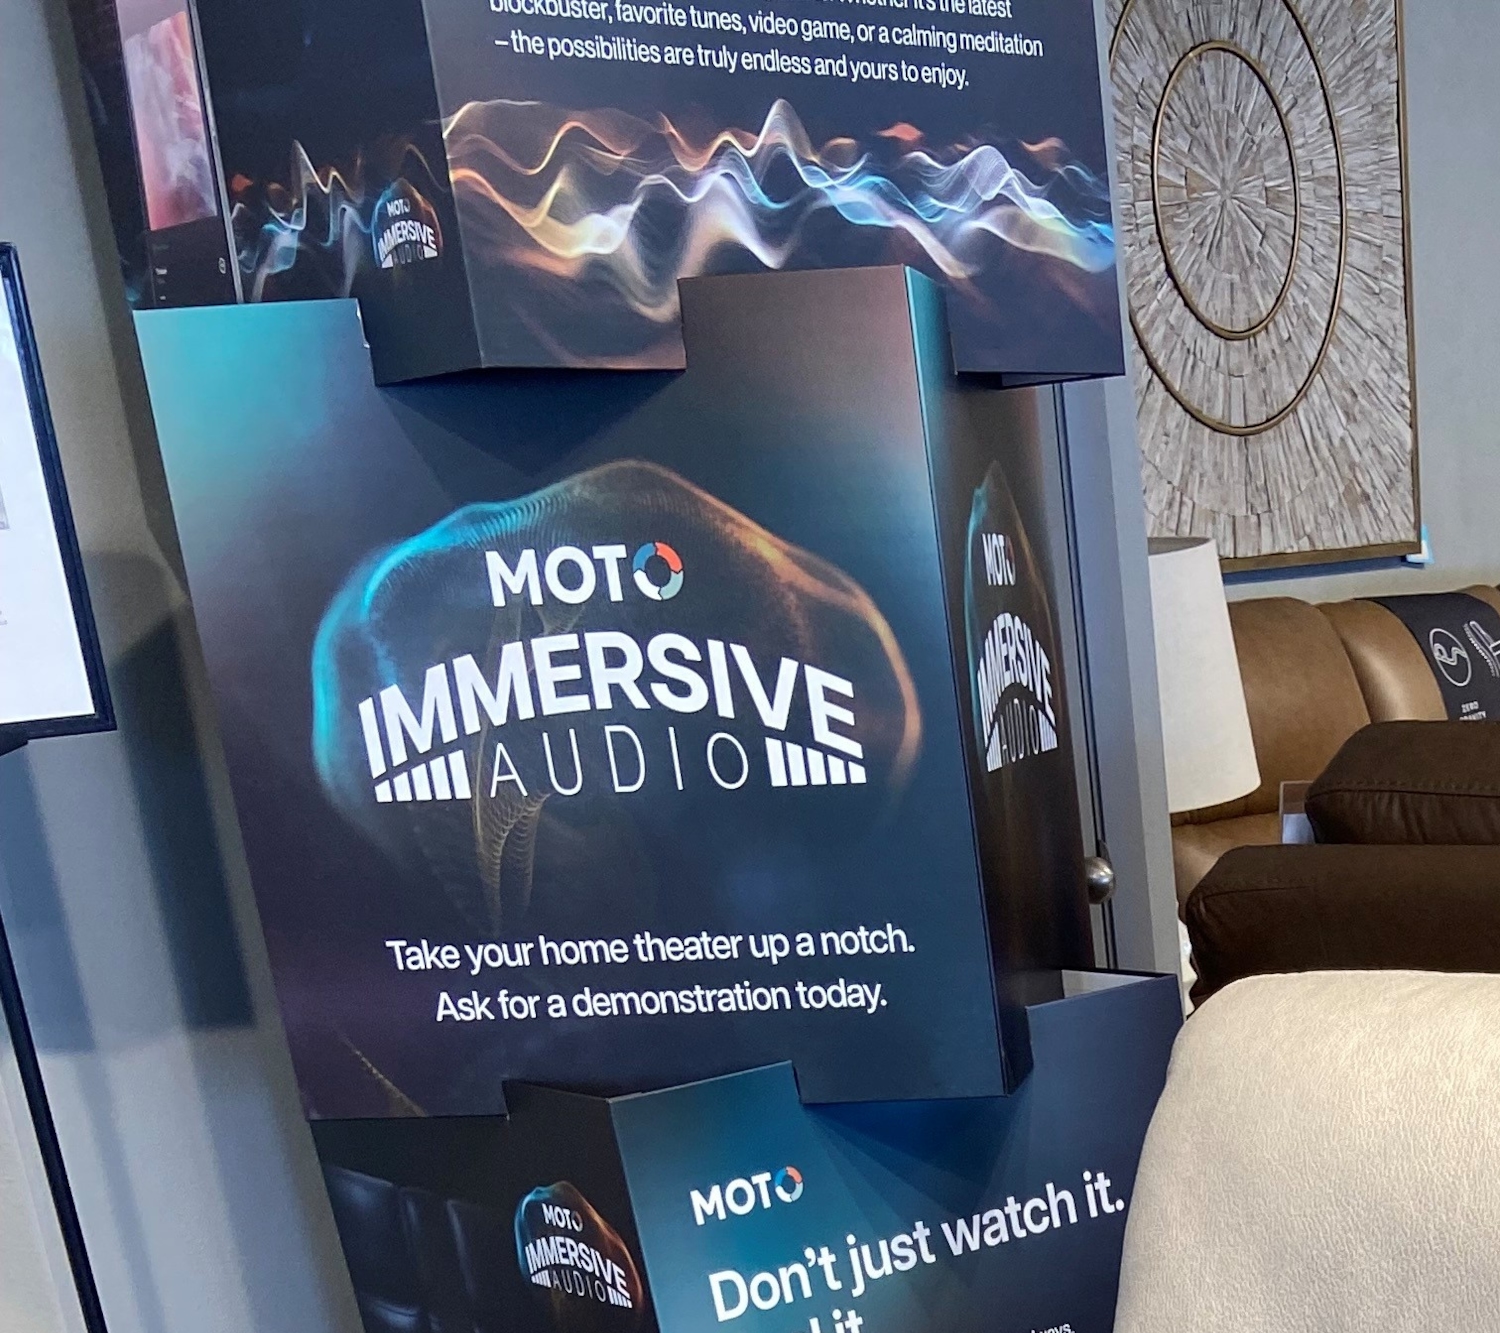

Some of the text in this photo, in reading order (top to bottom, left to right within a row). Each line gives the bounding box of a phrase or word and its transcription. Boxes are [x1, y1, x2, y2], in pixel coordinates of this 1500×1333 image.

[490, 0, 1044, 57] blockbuster, favorite tunes, video game, or a calming meditation
[968, 0, 1013, 18] latest
[511, 29, 545, 55] the
[548, 36, 662, 63] possibilities
[664, 47, 695, 67] are
[697, 44, 740, 73] truly
[741, 49, 812, 75] endless
[814, 54, 847, 78] and
[850, 61, 898, 82] yours
[901, 60, 920, 83] to
[921, 62, 970, 90] enjoy.
[386, 198, 411, 217] MOTO
[377, 220, 437, 262] IMMERSIVE
[392, 244, 424, 265] AUDIO
[485, 541, 684, 607] MOTO
[982, 533, 1016, 586] MOTO
[358, 631, 865, 779] IMMERSIVE
[977, 612, 1056, 748] IMMERSIVE
[1000, 698, 1040, 766] AUDIO
[490, 725, 749, 799] AUDIO
[385, 923, 915, 976] Take your home theater up a notch.
[435, 978, 888, 1022] Ask for a demonstration today.
[542, 1203, 583, 1232] MOTO
[690, 1165, 804, 1225] MOTO
[525, 1236, 631, 1299] IMMERSIVE
[708, 1170, 1125, 1322] Don't just watch it.
[552, 1269, 607, 1303] AUDIO
